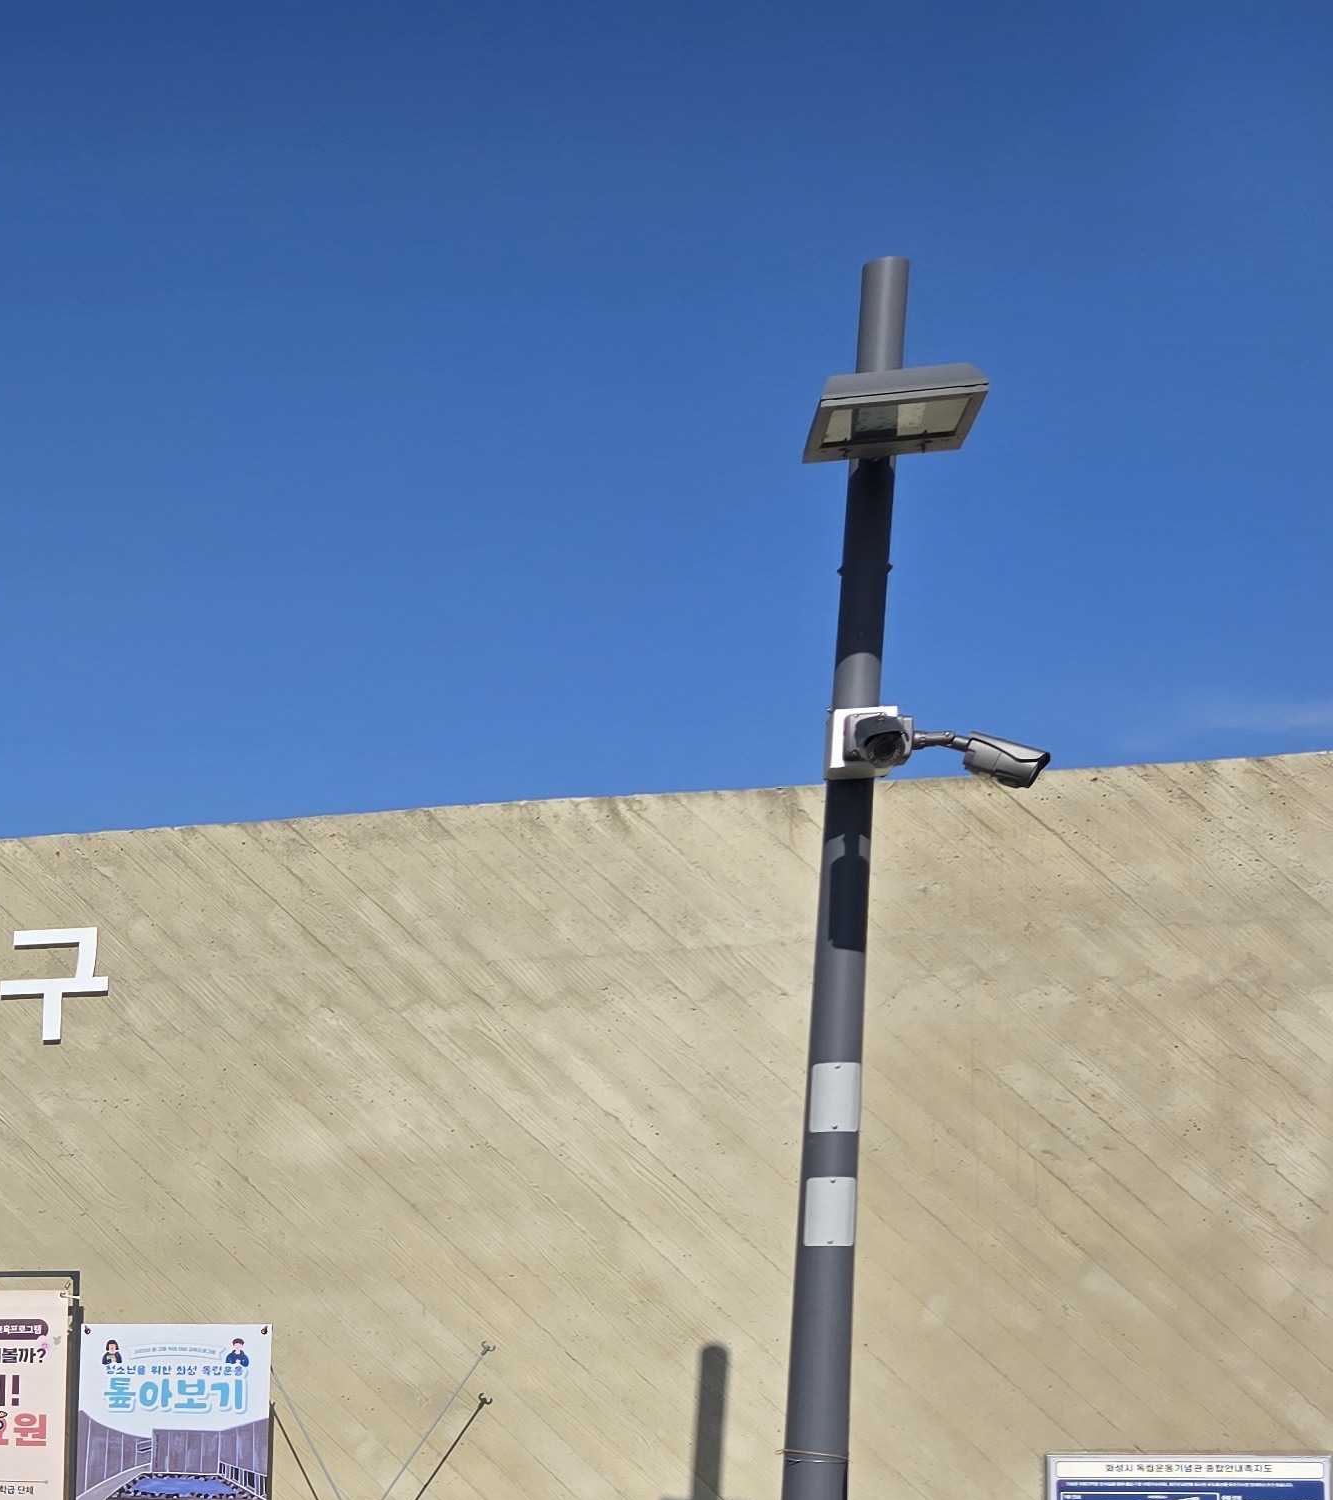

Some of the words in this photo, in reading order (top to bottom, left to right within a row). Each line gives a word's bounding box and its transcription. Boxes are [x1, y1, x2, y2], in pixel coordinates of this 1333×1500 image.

[106, 1365, 145, 1375] 청소년을
[151, 1365, 172, 1376] 위한
[202, 1365, 244, 1376] 독립운동
[104, 1377, 244, 1410] 톺아보기
[1106, 1464, 1133, 1472] 화성시
